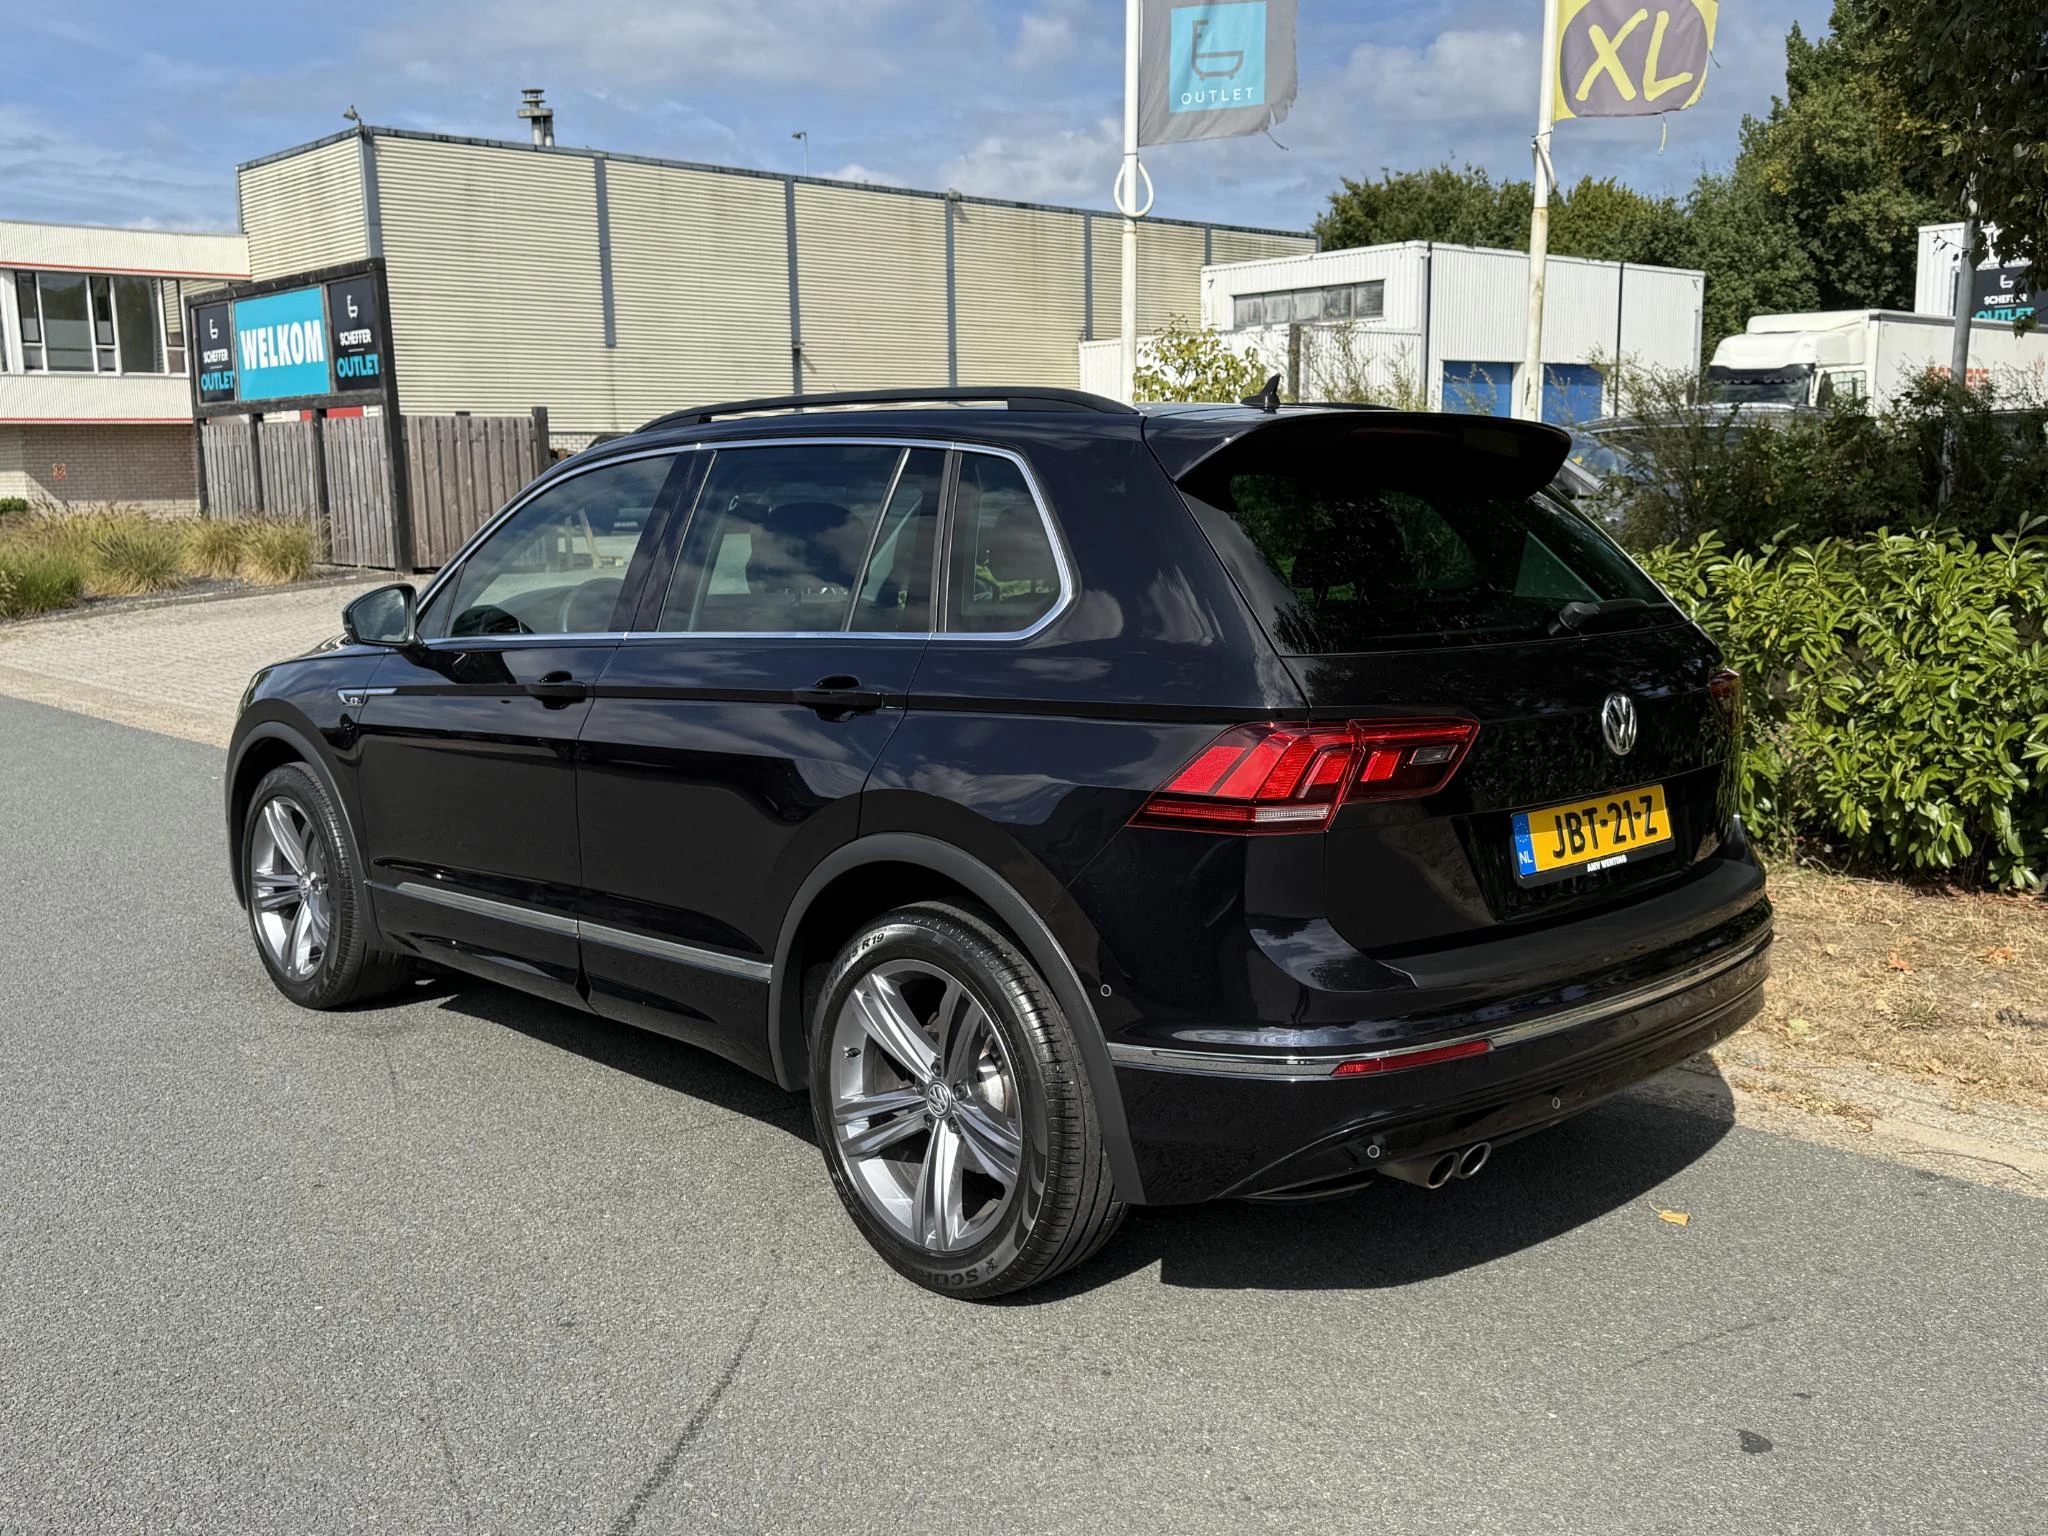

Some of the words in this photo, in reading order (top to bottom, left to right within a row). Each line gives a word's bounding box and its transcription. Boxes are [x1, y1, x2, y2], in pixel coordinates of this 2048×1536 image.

[1575, 8, 1694, 102] XL
[1180, 87, 1254, 105] OUTLET
[240, 319, 325, 370] WELKOM
[339, 328, 372, 347] SCHEFFER
[203, 348, 229, 364] SCHEFFER
[336, 353, 379, 378] OUTLET
[200, 370, 235, 391] OUTLET
[1552, 795, 1658, 859] JBT-21-Z
[1518, 850, 1533, 864] NL
[861, 932, 885, 950] R19
